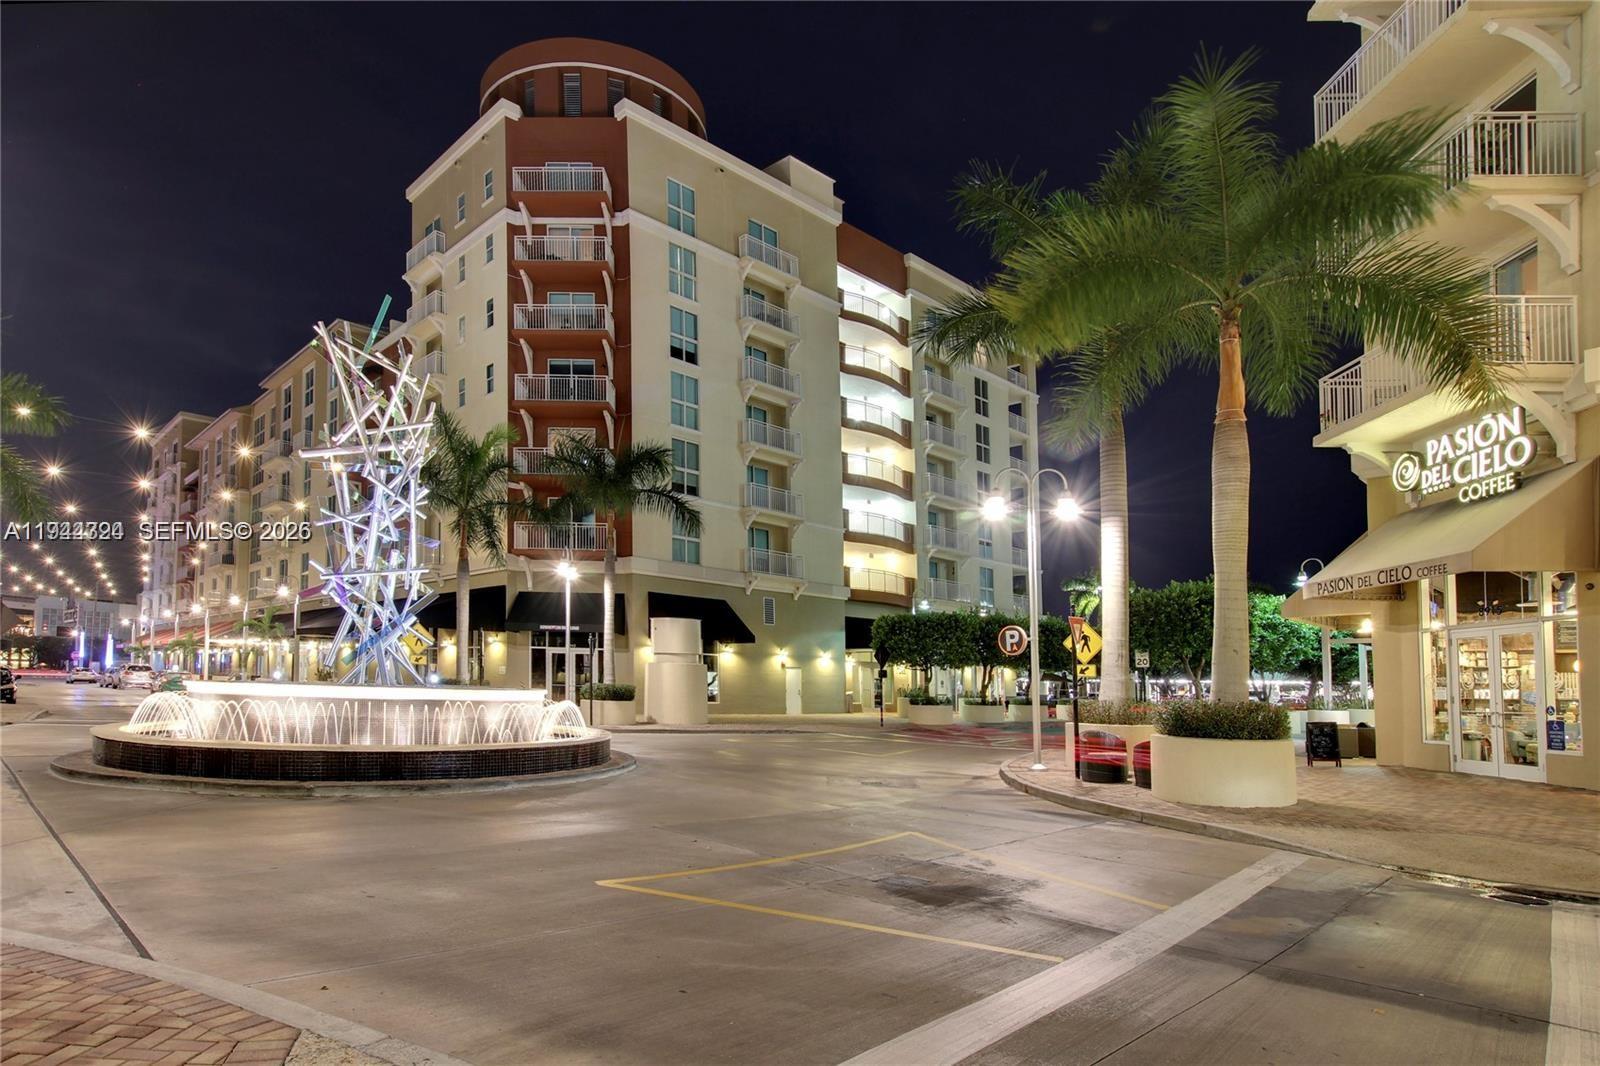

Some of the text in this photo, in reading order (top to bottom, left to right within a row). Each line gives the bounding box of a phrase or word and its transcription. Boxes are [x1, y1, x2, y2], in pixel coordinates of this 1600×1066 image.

[1421, 436, 1532, 489] DEL CIELO
[1458, 471, 1516, 503] COFFEE
[1357, 575, 1373, 589] DEL
[1377, 565, 1412, 585] CIELO
[1416, 563, 1448, 578] COFFEE
[1136, 658, 1149, 666] 20
